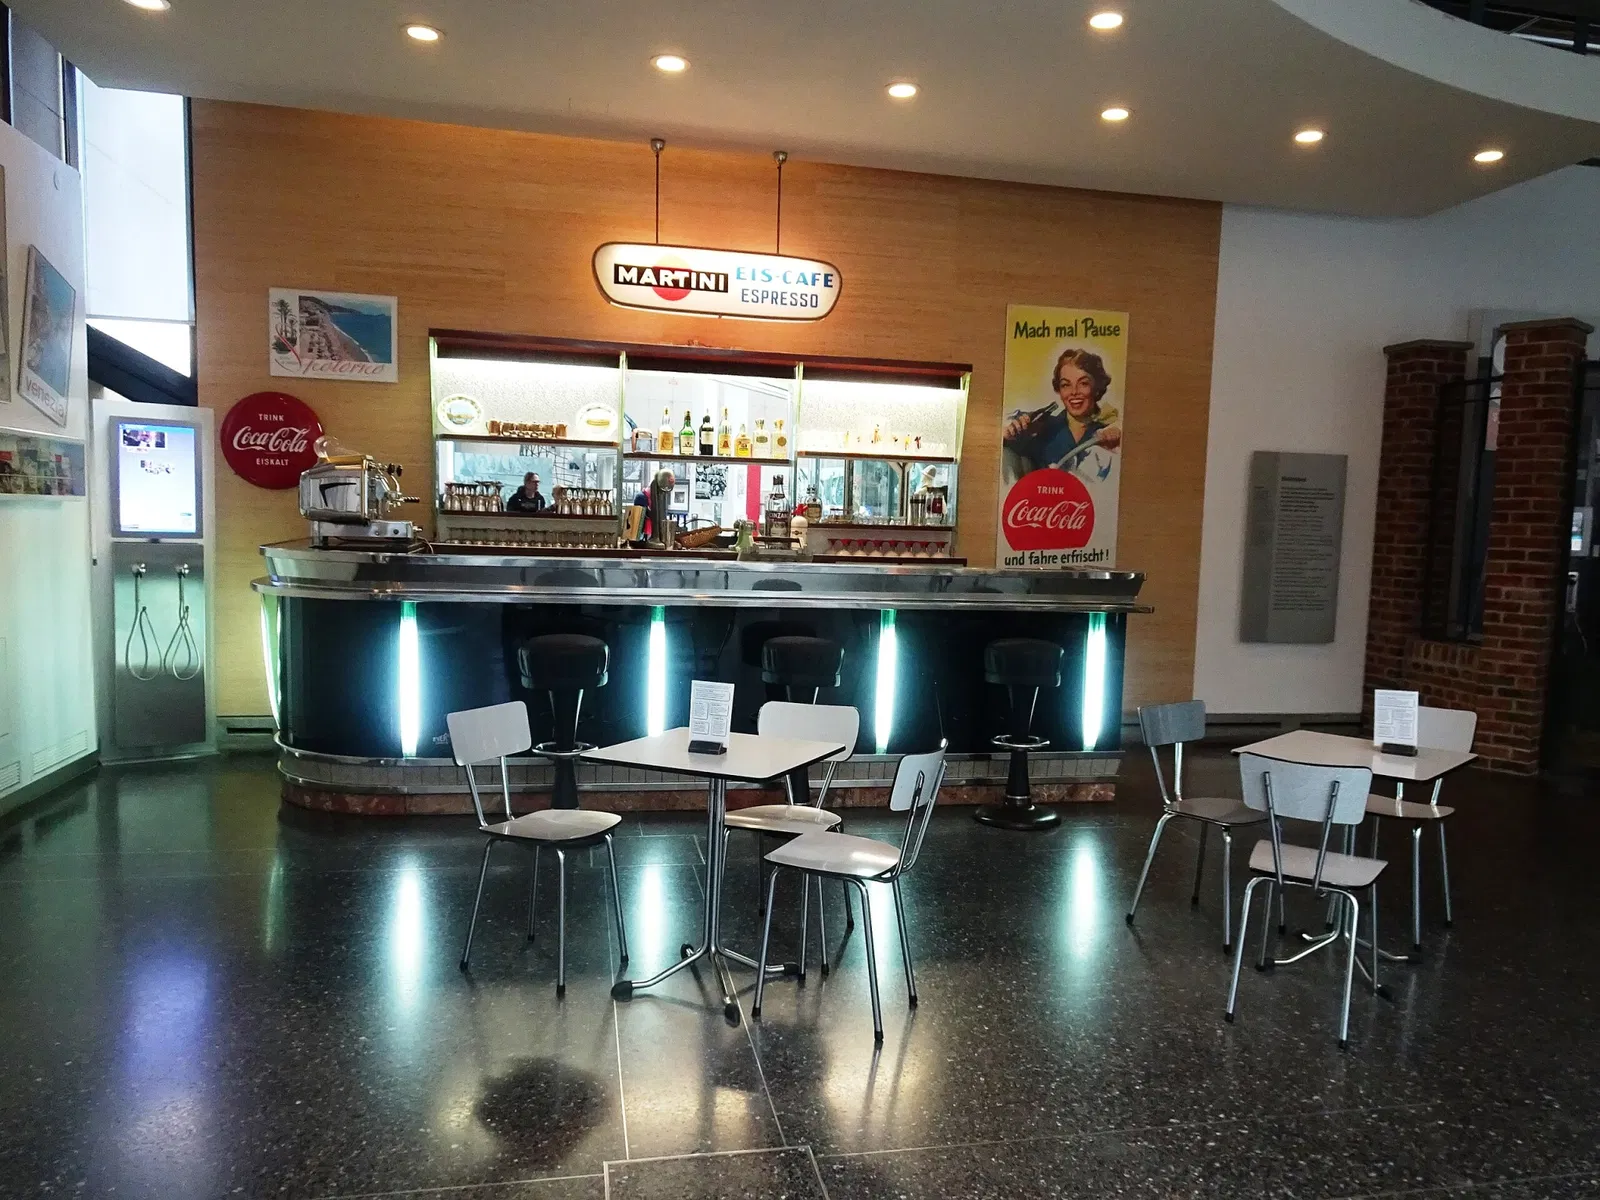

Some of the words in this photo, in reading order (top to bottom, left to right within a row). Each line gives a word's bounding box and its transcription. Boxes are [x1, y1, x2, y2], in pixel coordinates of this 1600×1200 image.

[617, 265, 726, 292] MARTINI
[741, 288, 819, 308] ESPRESSO
[1014, 320, 1050, 339] Mach
[1055, 319, 1078, 338] mal
[1081, 317, 1120, 338] Pause
[258, 413, 284, 422] TRINK
[232, 425, 311, 453] Coca-Cola
[256, 458, 289, 466] EISKALT
[1037, 485, 1065, 495] TRINK
[1007, 498, 1091, 530] Coca-Cola
[1004, 551, 1025, 566] und
[1028, 550, 1058, 565] fahre
[1060, 547, 1109, 564] erfrischt!
